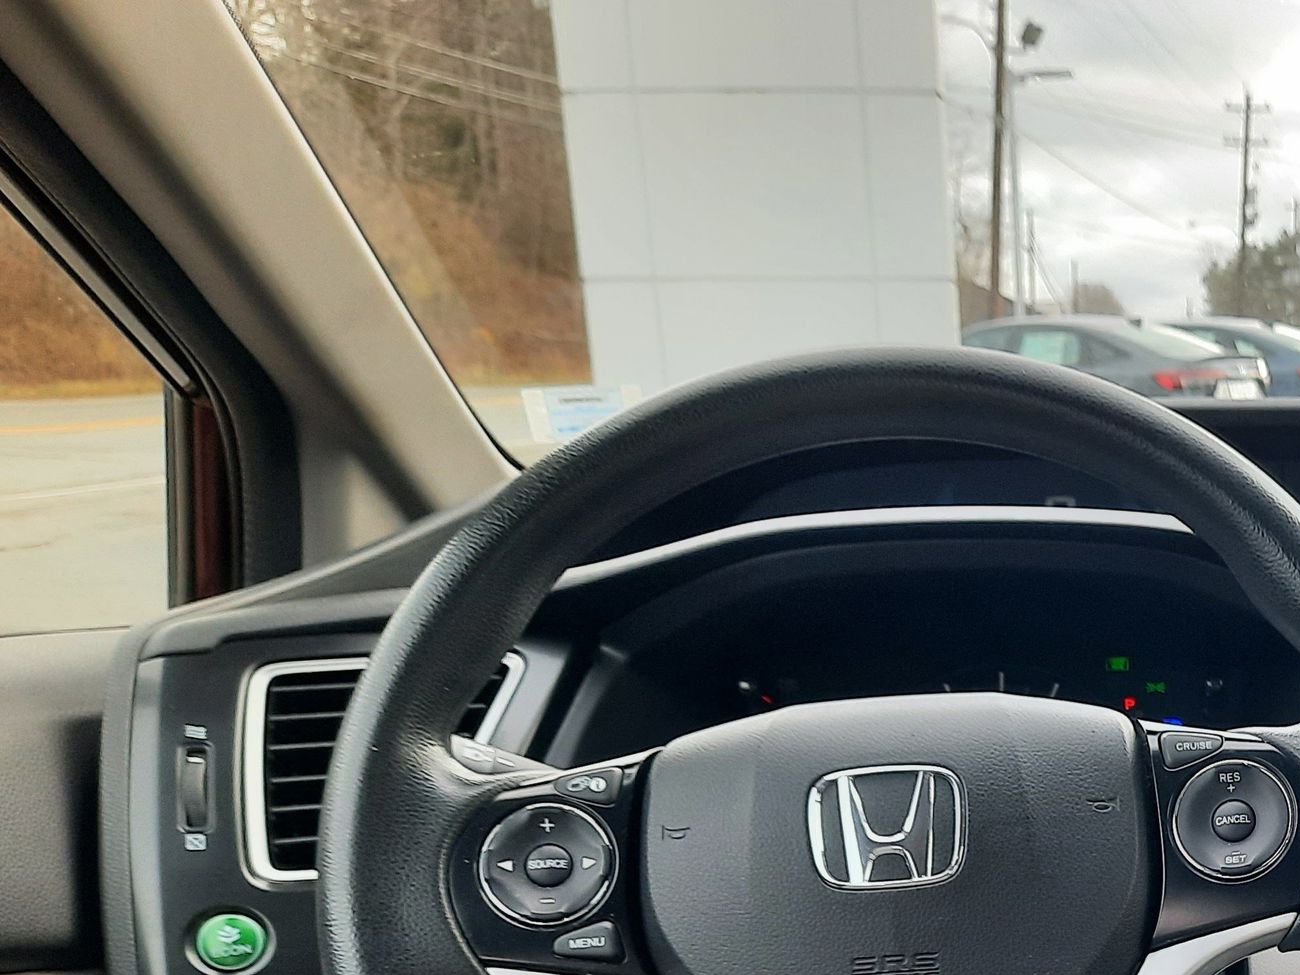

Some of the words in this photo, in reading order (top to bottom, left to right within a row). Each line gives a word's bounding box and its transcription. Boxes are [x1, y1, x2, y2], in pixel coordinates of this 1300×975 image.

[1125, 698, 1134, 710] P
[1176, 741, 1212, 751] CRUISE
[1219, 772, 1240, 783] RES
[1215, 815, 1250, 826] CANCEL
[1225, 854, 1246, 864] SET
[528, 860, 568, 870] SOURCE
[569, 937, 606, 949] MENU
[852, 952, 940, 973] SRS
